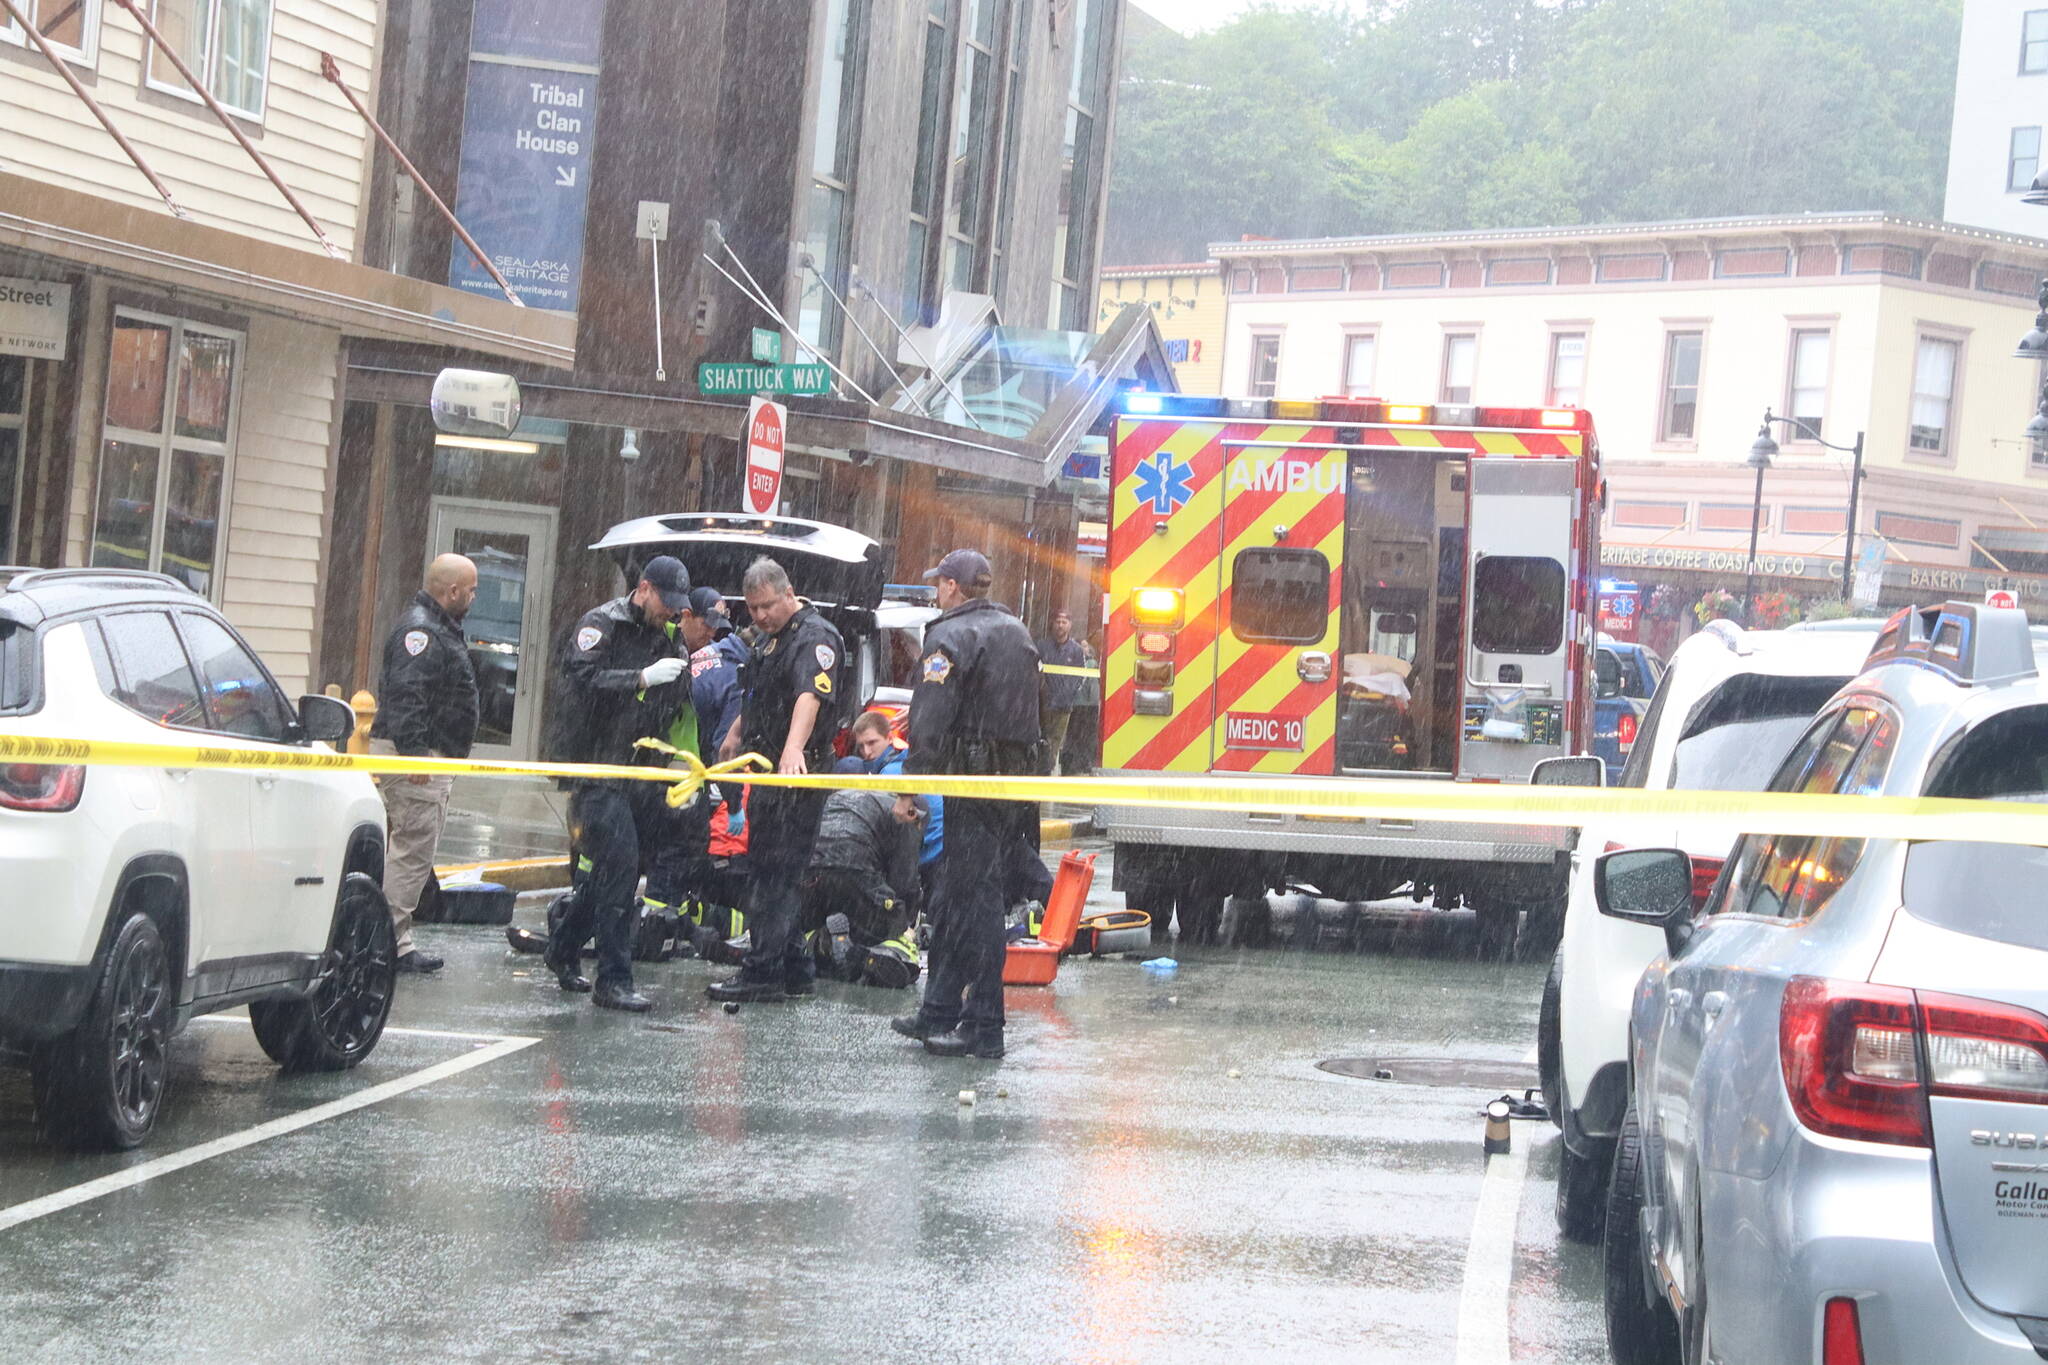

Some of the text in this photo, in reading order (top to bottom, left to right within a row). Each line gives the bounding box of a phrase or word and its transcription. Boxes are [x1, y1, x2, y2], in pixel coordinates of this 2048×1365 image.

[530, 83, 584, 108] Tribal
[537, 109, 581, 133] Clan
[516, 129, 579, 155] House
[495, 255, 570, 273] SEALASKA
[495, 265, 570, 284] HERITAGE
[0, 285, 53, 307] Street
[9, 337, 57, 352] NETWORK
[1192, 339, 1202, 363] 2
[704, 368, 825, 390] SHATTUCK WAY
[754, 421, 780, 445] DO NOT
[752, 472, 774, 494] ENTER
[1600, 546, 1649, 565] ERITAGE
[1654, 549, 1701, 568] COFFEE
[1708, 552, 1777, 574] ROASTNG
[1782, 557, 1805, 576] CO
[1910, 568, 1967, 590] BAKERY
[1604, 618, 1627, 629] MEDIC
[1228, 718, 1302, 742] MEDIC 10
[1996, 1199, 2027, 1209] Motor
